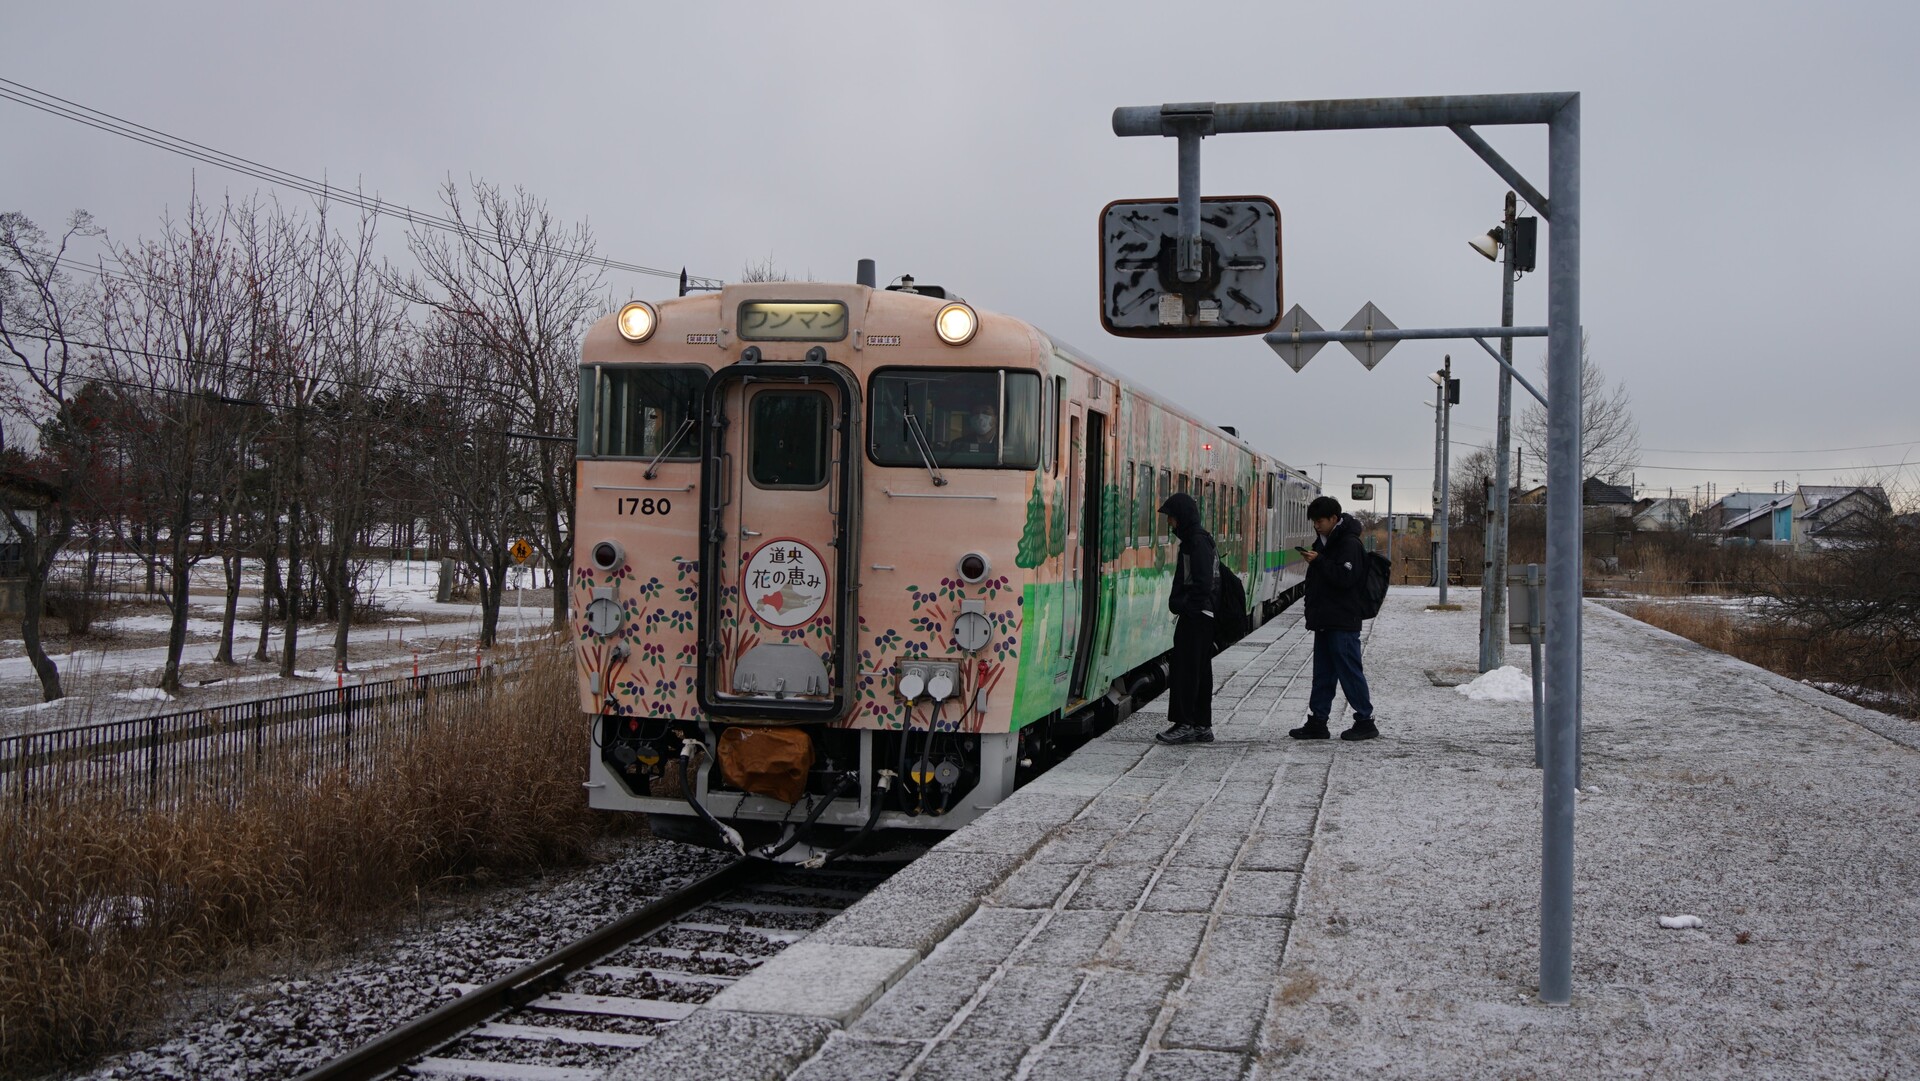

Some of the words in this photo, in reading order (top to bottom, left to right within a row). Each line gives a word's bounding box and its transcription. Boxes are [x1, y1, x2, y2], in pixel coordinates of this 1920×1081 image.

[744, 311, 844, 329] ワンマン
[618, 497, 671, 515] 1780
[769, 546, 803, 564] 道央
[752, 565, 822, 589] 花の恵み
